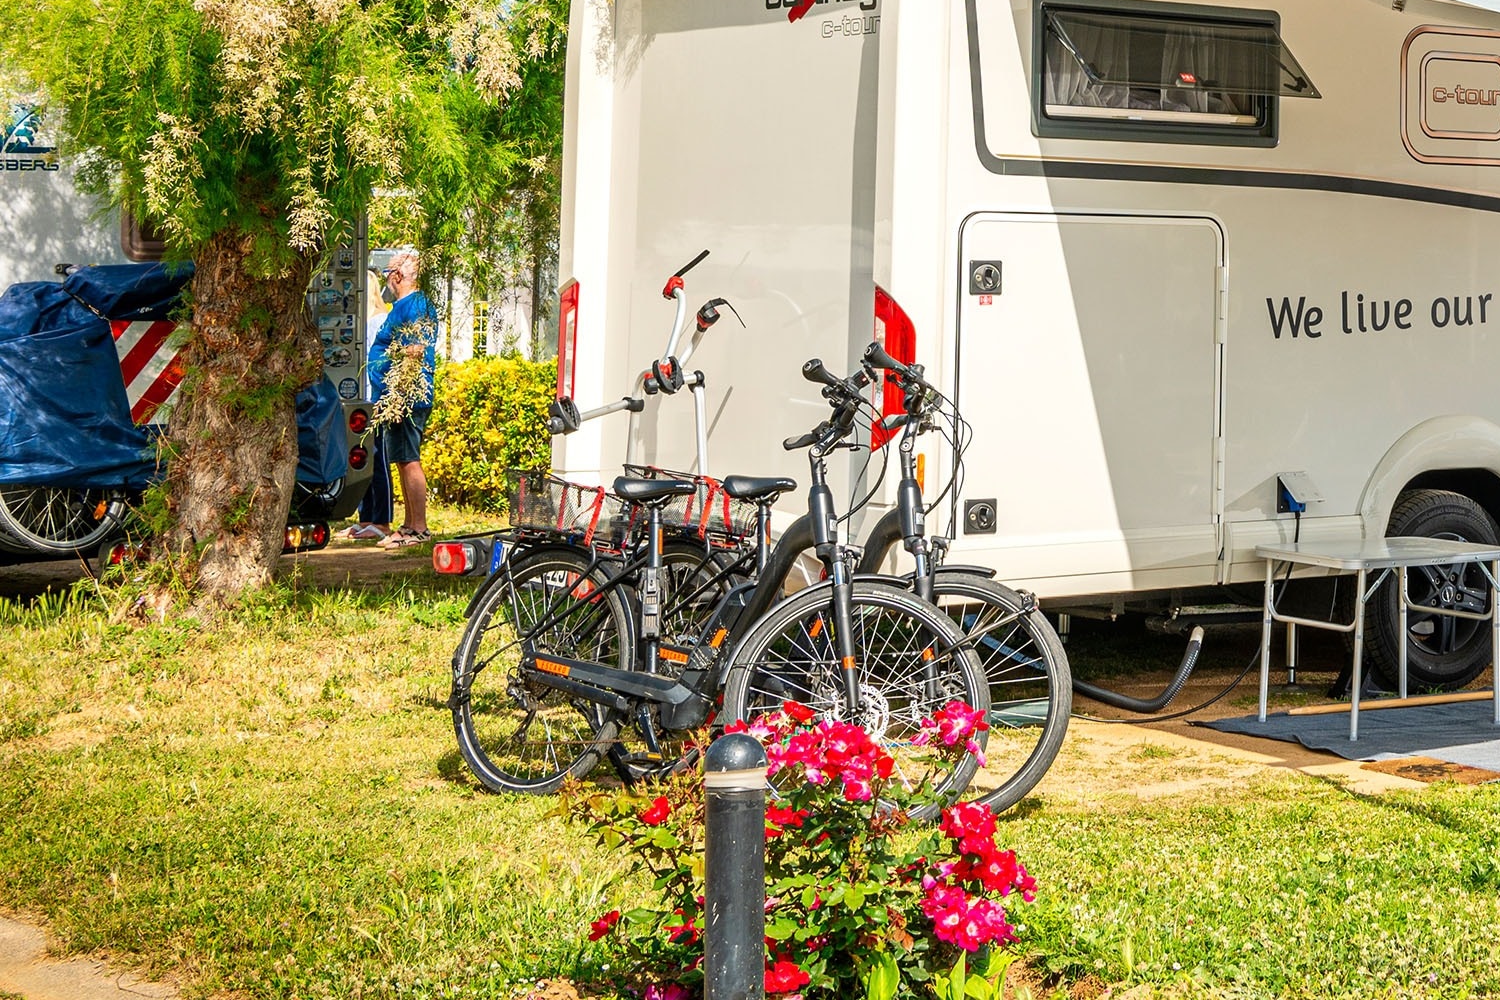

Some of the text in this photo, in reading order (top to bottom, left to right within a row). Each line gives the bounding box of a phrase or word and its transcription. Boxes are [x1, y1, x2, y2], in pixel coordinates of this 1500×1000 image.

[1266, 296, 1323, 339] We
[1341, 290, 1413, 334] live
[1431, 293, 1492, 328] our
